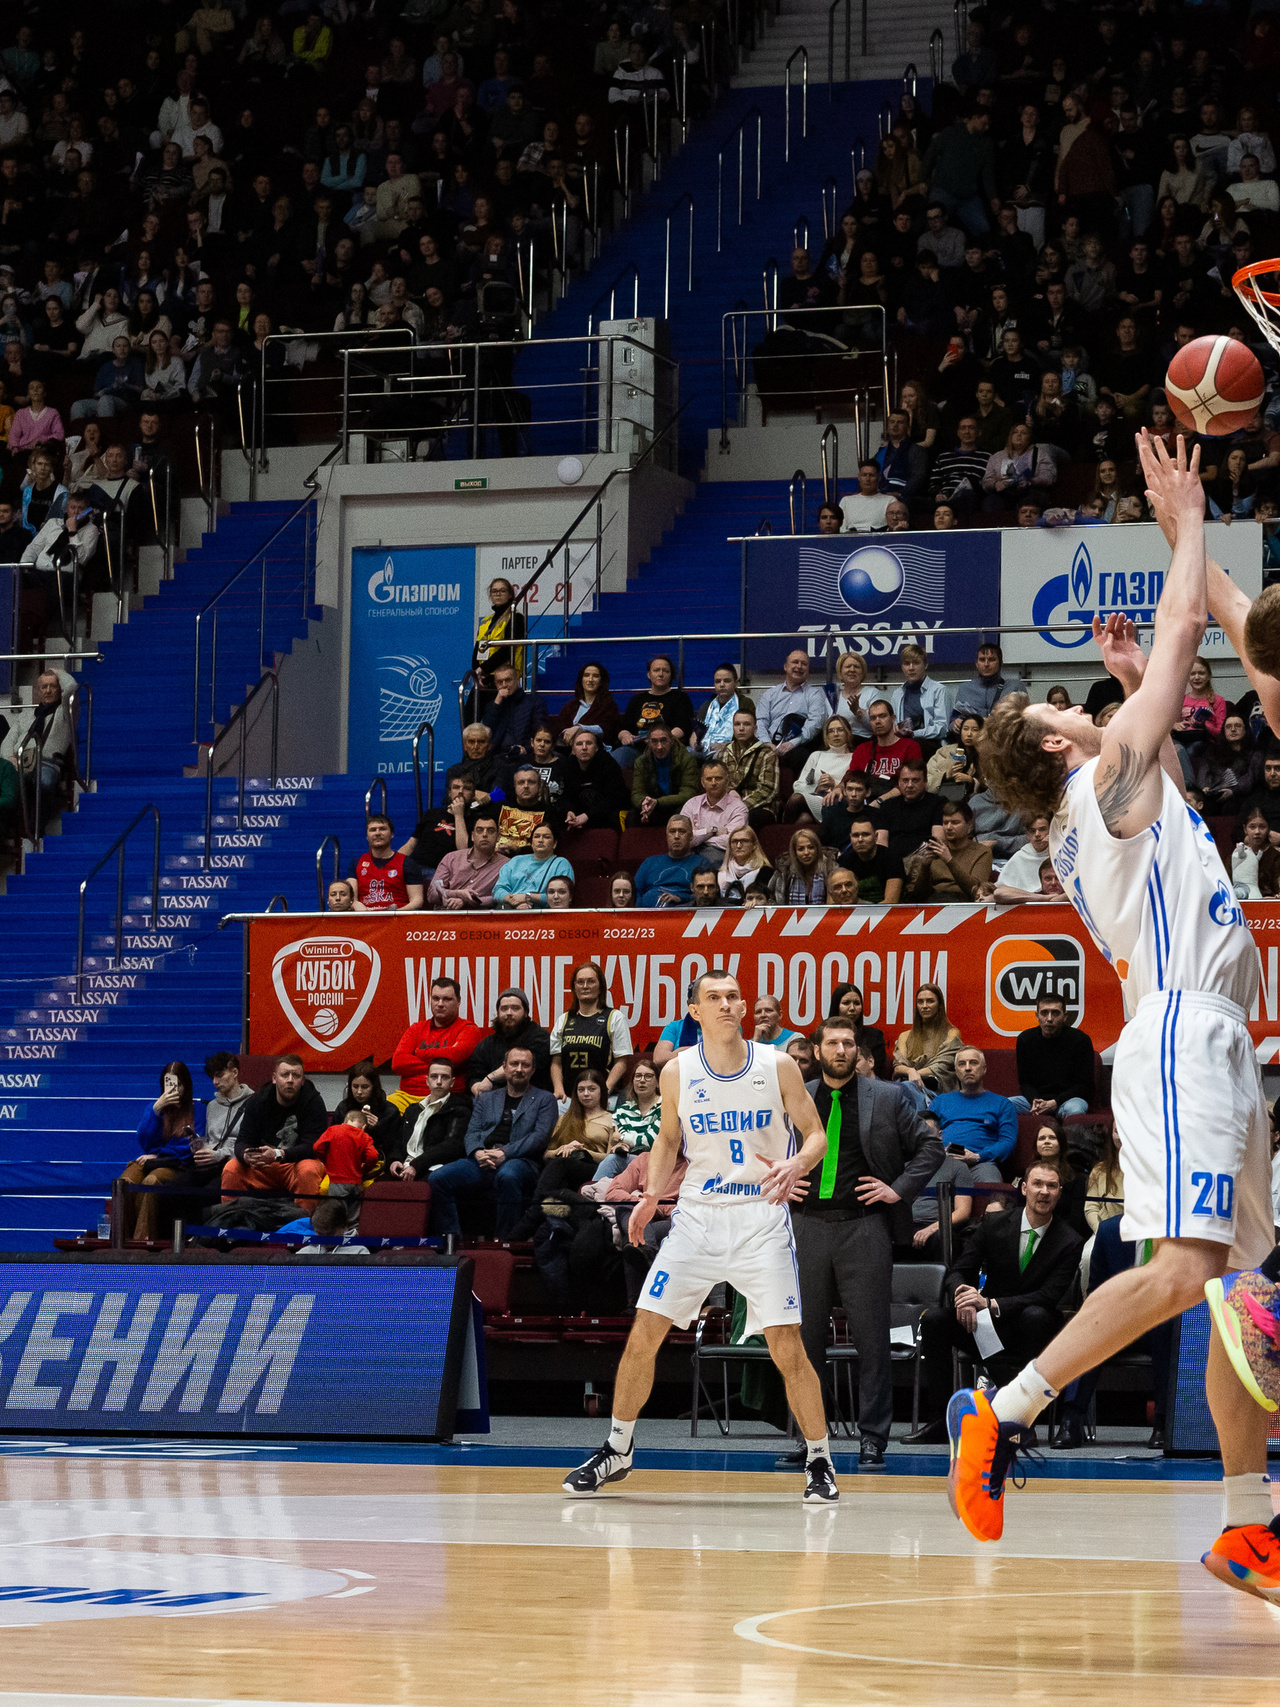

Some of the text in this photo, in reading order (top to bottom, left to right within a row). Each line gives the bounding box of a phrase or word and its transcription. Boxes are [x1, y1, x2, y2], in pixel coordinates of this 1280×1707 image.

[502, 556, 538, 570] ПАРТЕР
[394, 583, 461, 603] ГАЗПРОМ
[368, 606, 460, 618] ГЕНЕРАЛЬНЫЙ СПОНСОР
[797, 620, 944, 658] TASSAY
[268, 778, 314, 789] ASSAY
[251, 795, 298, 806] TASSAY
[215, 834, 263, 847] TASSAY
[180, 876, 229, 888] TASSAY
[161, 896, 211, 908] TASSAY
[406, 928, 655, 941] 2022/23 СЕЗОН 2022/23 СЕЗОН 2022/23
[124, 936, 174, 948] TASSAY
[305, 944, 339, 955] Winline
[87, 976, 137, 988] TASSAY
[296, 960, 356, 991] КУБОК
[757, 950, 948, 1026] РОССИИ
[1008, 972, 1076, 1001] Win
[308, 993, 344, 1006] РОССИИ
[48, 1010, 99, 1023] TASSAY
[27, 1028, 78, 1040] TASSAY
[5, 1045, 57, 1058] TASSAY
[569, 1052, 589, 1068] 23
[0, 1074, 41, 1087] ASSAY
[690, 1110, 773, 1135] ЗЕНИТ
[729, 1139, 745, 1166] 8
[714, 1182, 761, 1196] АЗПРОМ
[1191, 1171, 1234, 1220] 20
[649, 1270, 671, 1299] 8
